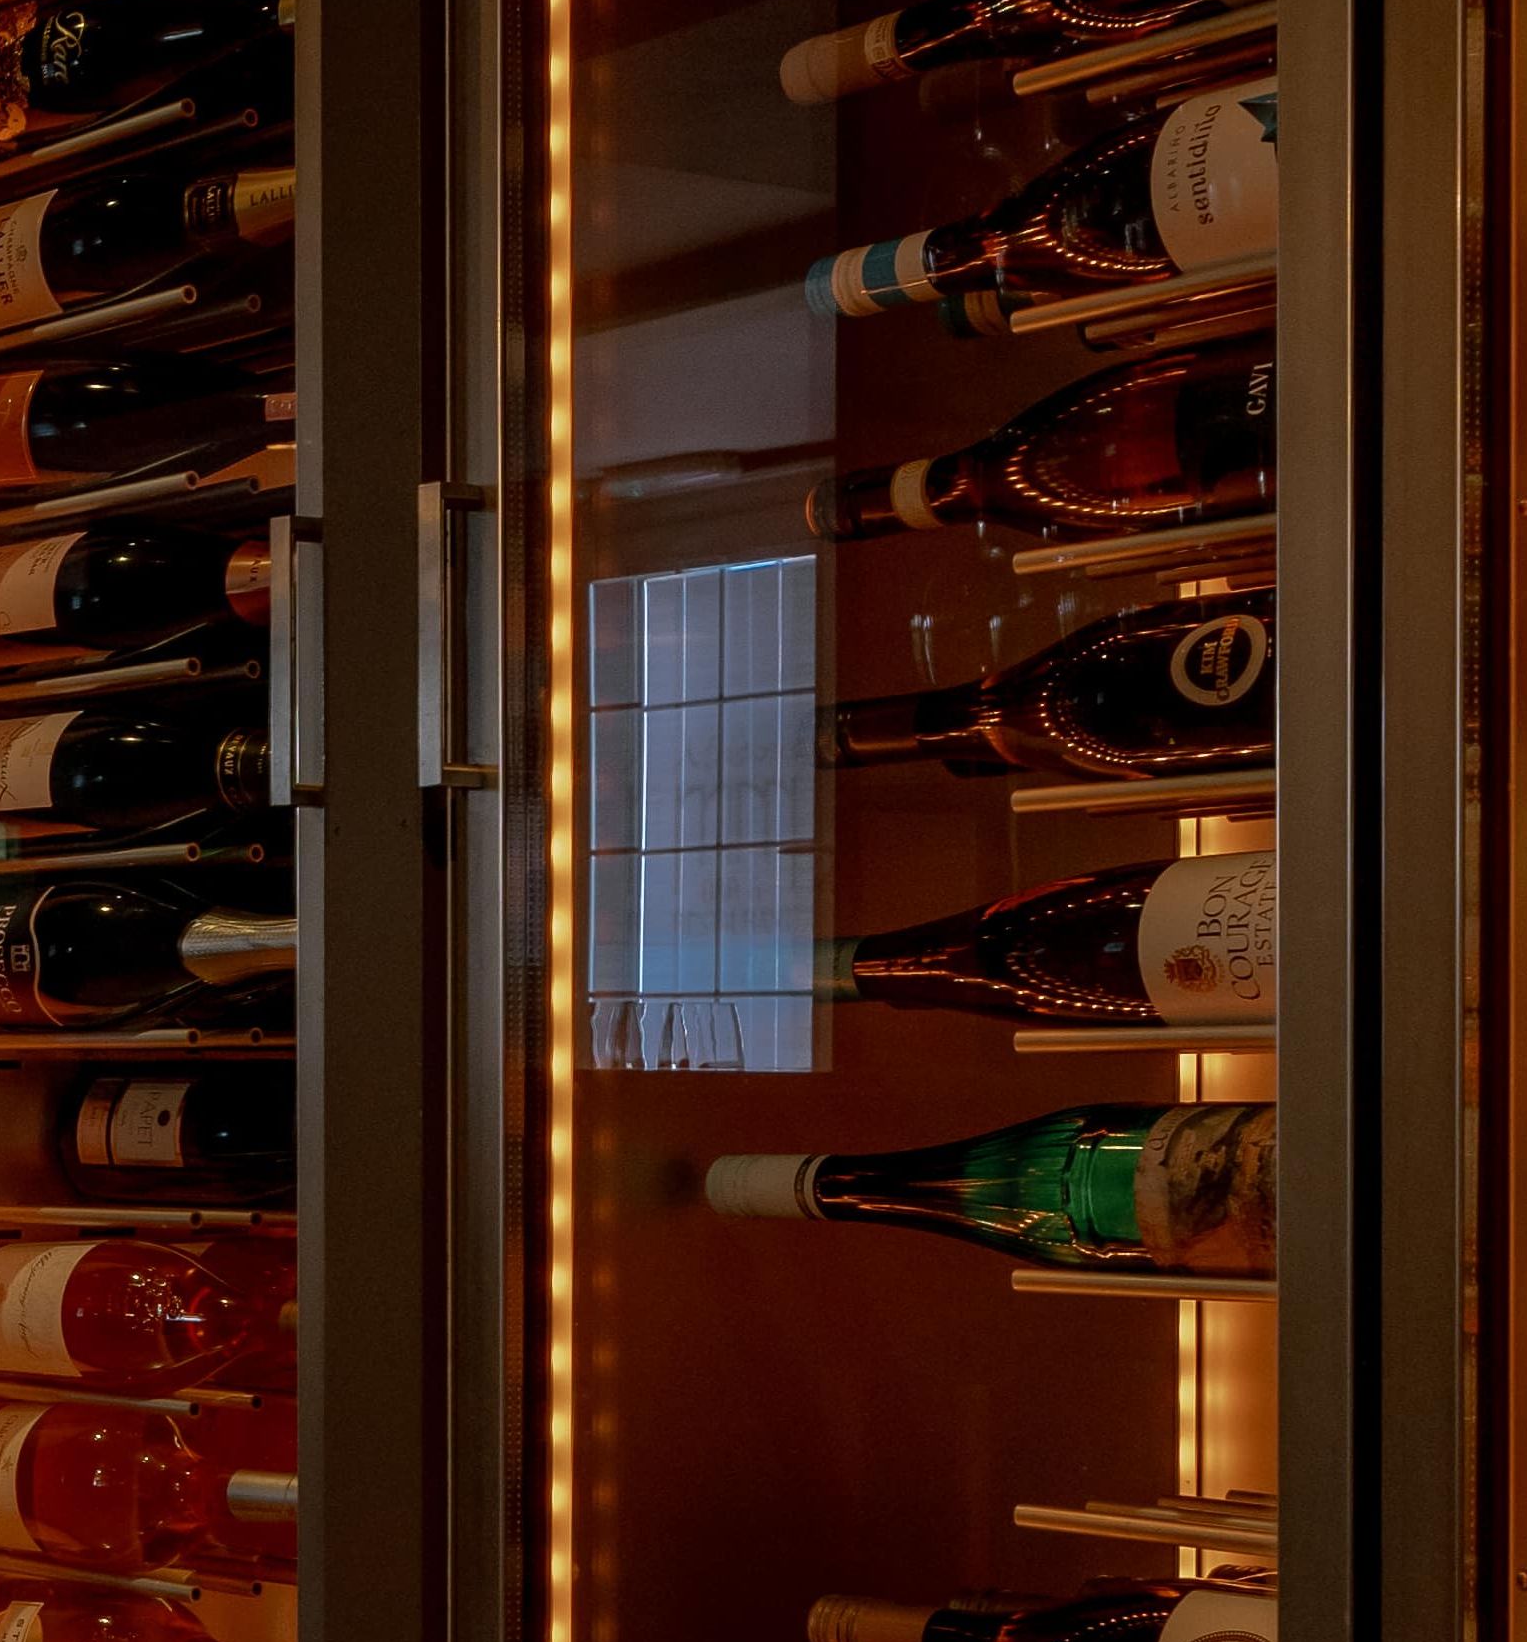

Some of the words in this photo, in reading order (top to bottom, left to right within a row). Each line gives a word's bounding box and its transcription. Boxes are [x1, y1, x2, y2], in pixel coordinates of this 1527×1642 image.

[50, 11, 86, 86] Rare
[249, 185, 295, 207] LALLI
[1185, 104, 1222, 226] sentidiño
[1245, 360, 1275, 416] GAVI
[1199, 640, 1219, 676] KIM
[1215, 616, 1242, 702] CRAWFORD
[1196, 875, 1238, 938] BON
